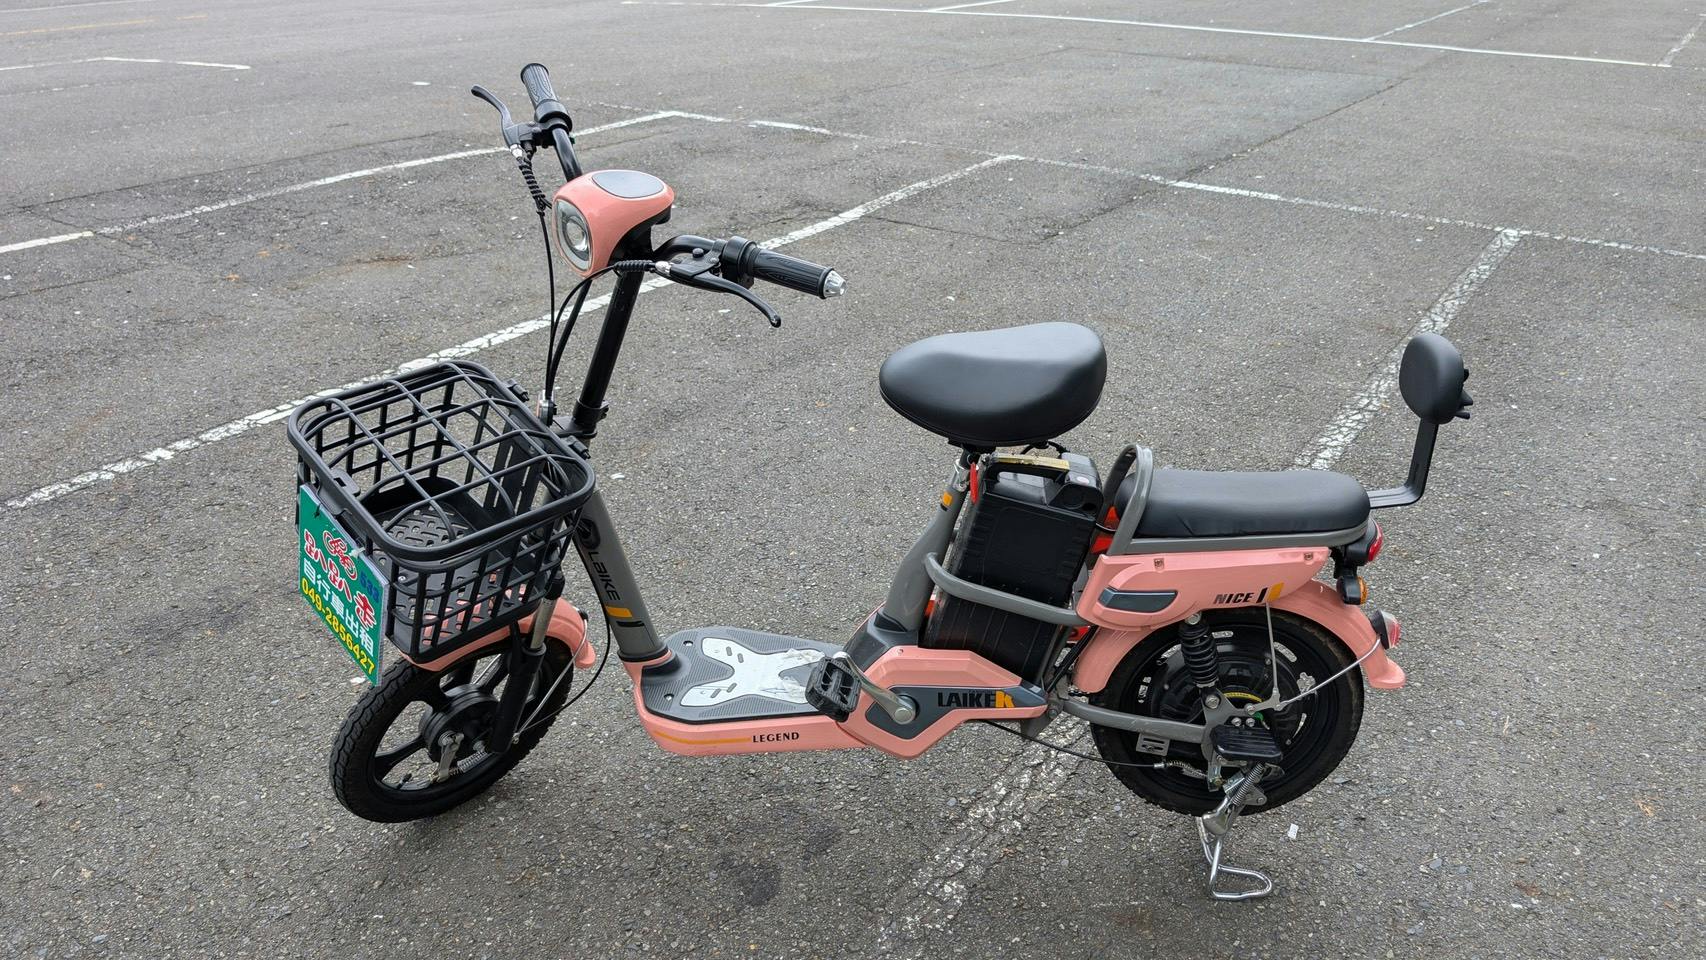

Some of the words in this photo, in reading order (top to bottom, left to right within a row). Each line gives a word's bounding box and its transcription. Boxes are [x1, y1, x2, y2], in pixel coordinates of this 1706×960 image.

[304, 558, 374, 657] 自行車出租
[1213, 592, 1255, 604] NICE
[302, 577, 375, 675] 049-2856427
[752, 731, 800, 743] LEGEND
